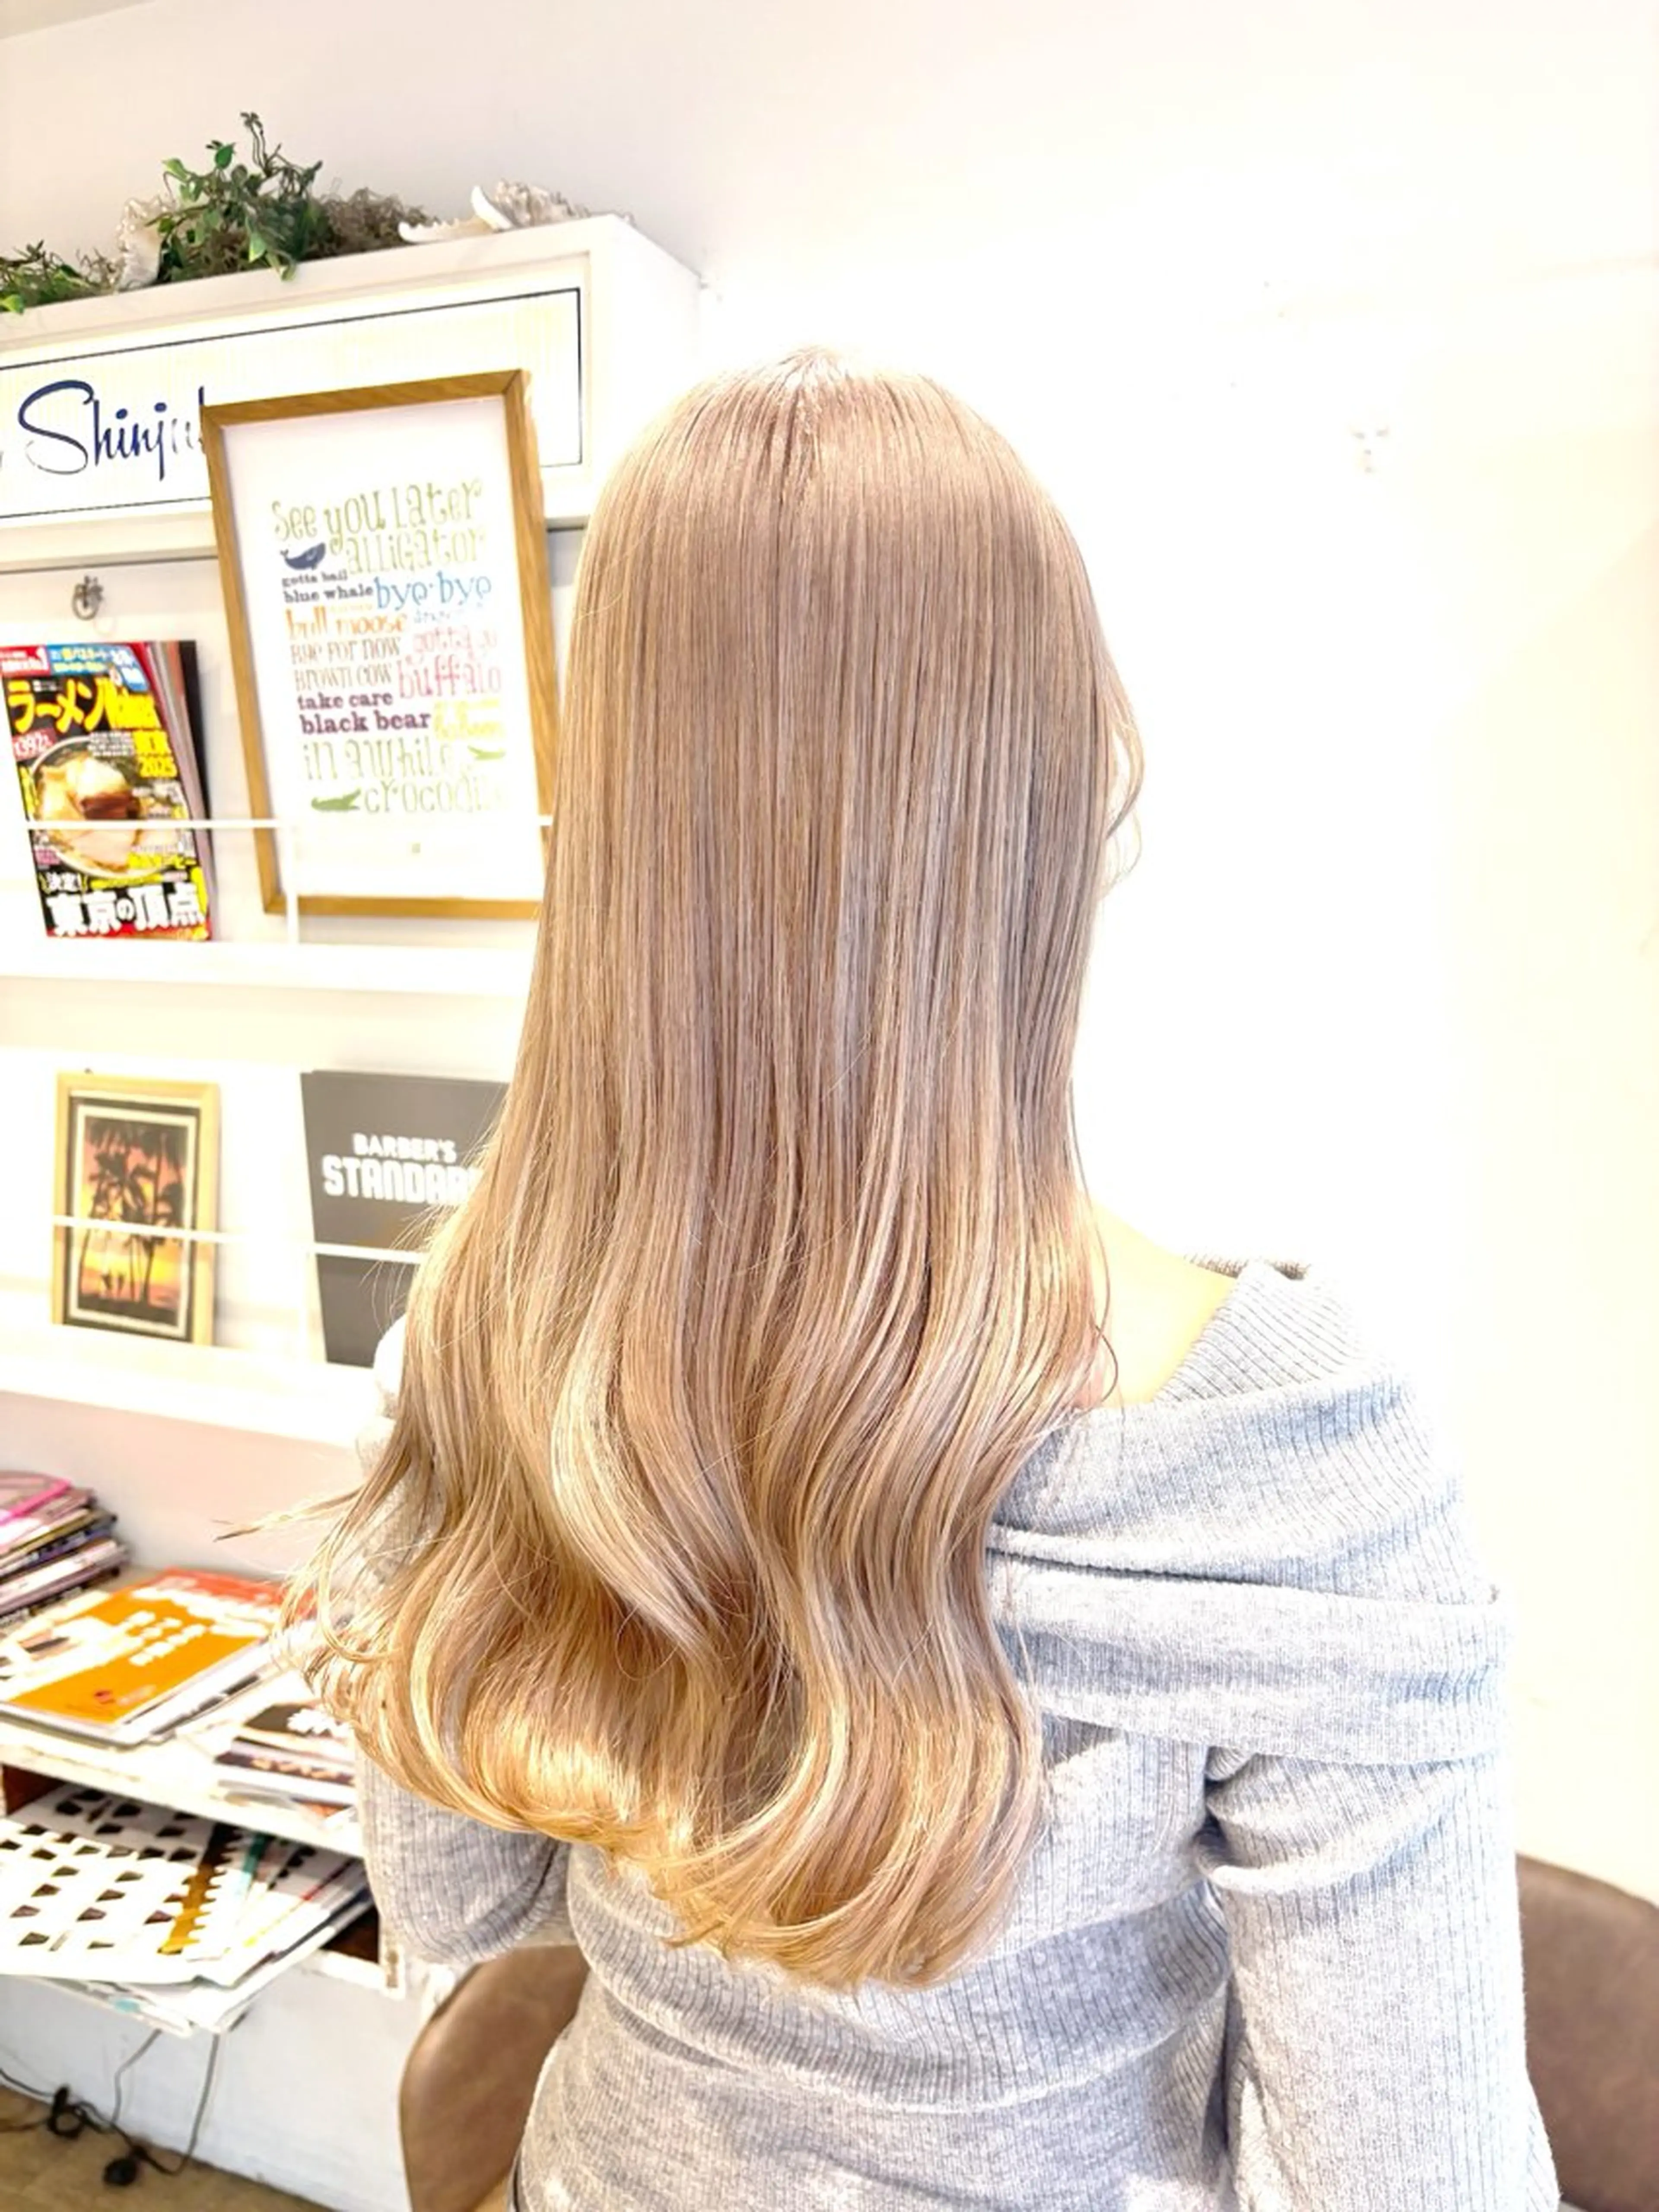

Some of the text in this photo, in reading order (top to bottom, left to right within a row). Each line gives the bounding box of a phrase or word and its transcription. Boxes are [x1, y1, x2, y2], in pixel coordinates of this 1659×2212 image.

[324, 490, 386, 556] you
[283, 582, 373, 603] blue whale
[397, 654, 502, 699] buffalo
[298, 692, 393, 711] take care
[299, 712, 369, 735] black
[374, 711, 431, 731] bear
[46, 882, 205, 936] 東京の頂点
[352, 1132, 457, 1163] BARBER'S
